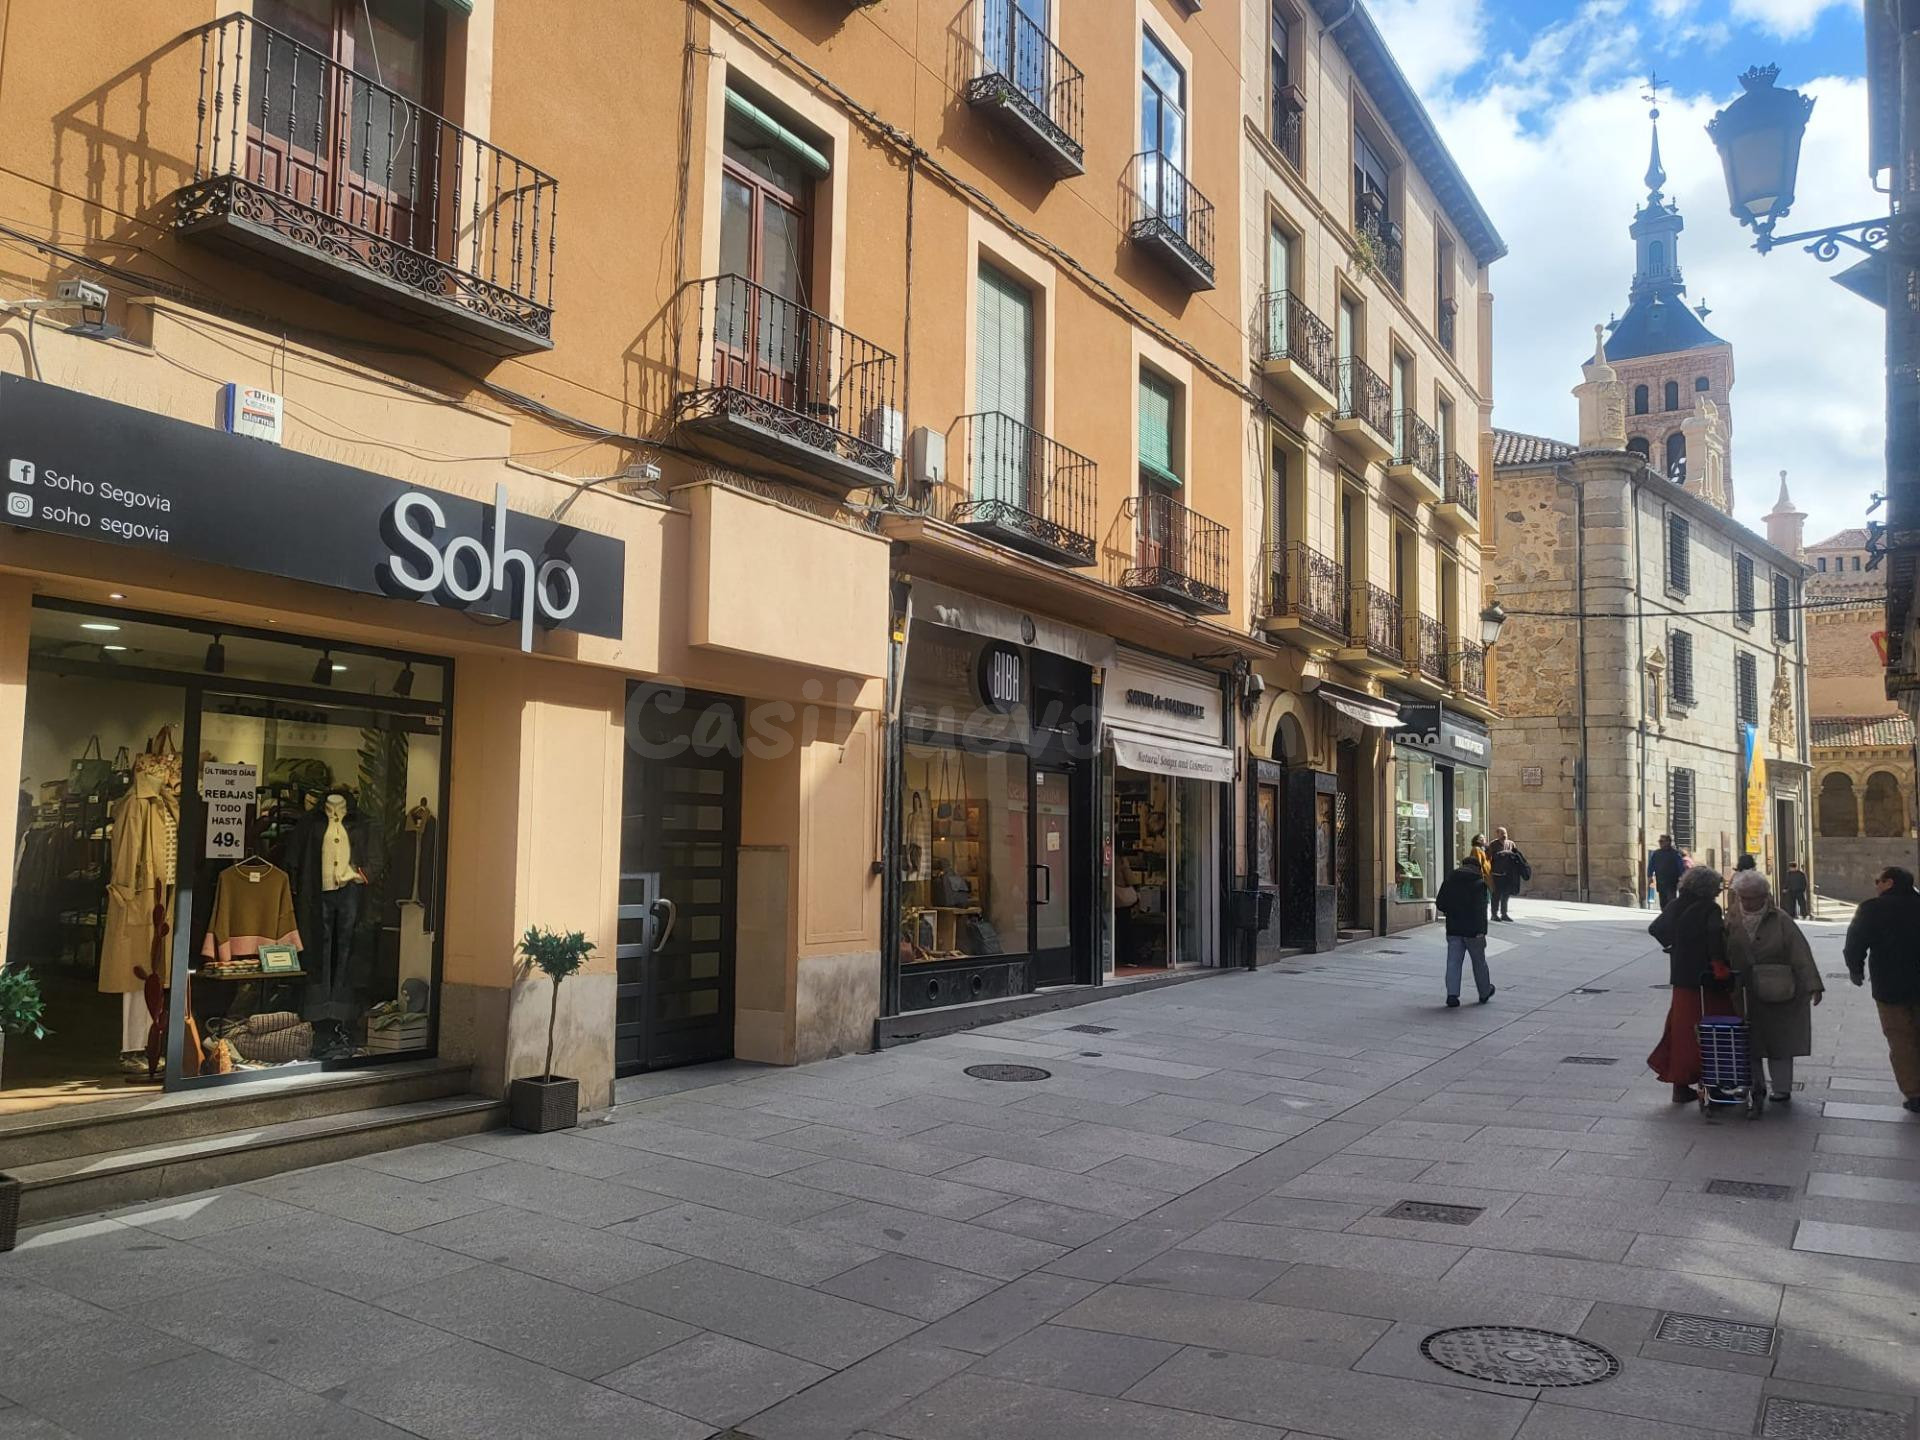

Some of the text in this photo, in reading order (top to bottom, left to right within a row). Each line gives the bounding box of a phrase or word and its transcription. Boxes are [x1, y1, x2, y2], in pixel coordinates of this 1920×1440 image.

[244, 412, 275, 428] alarma
[44, 469, 171, 512] Soho Segovia
[42, 506, 169, 543] soho segovia
[389, 482, 579, 653] Soho
[994, 651, 1019, 702] BIBA
[205, 767, 256, 777] ÚLTIMOS DÍAS
[205, 789, 254, 800] REBAJAS
[215, 804, 241, 812] TODO
[211, 817, 243, 826] HASTA
[212, 831, 241, 847] 49€
